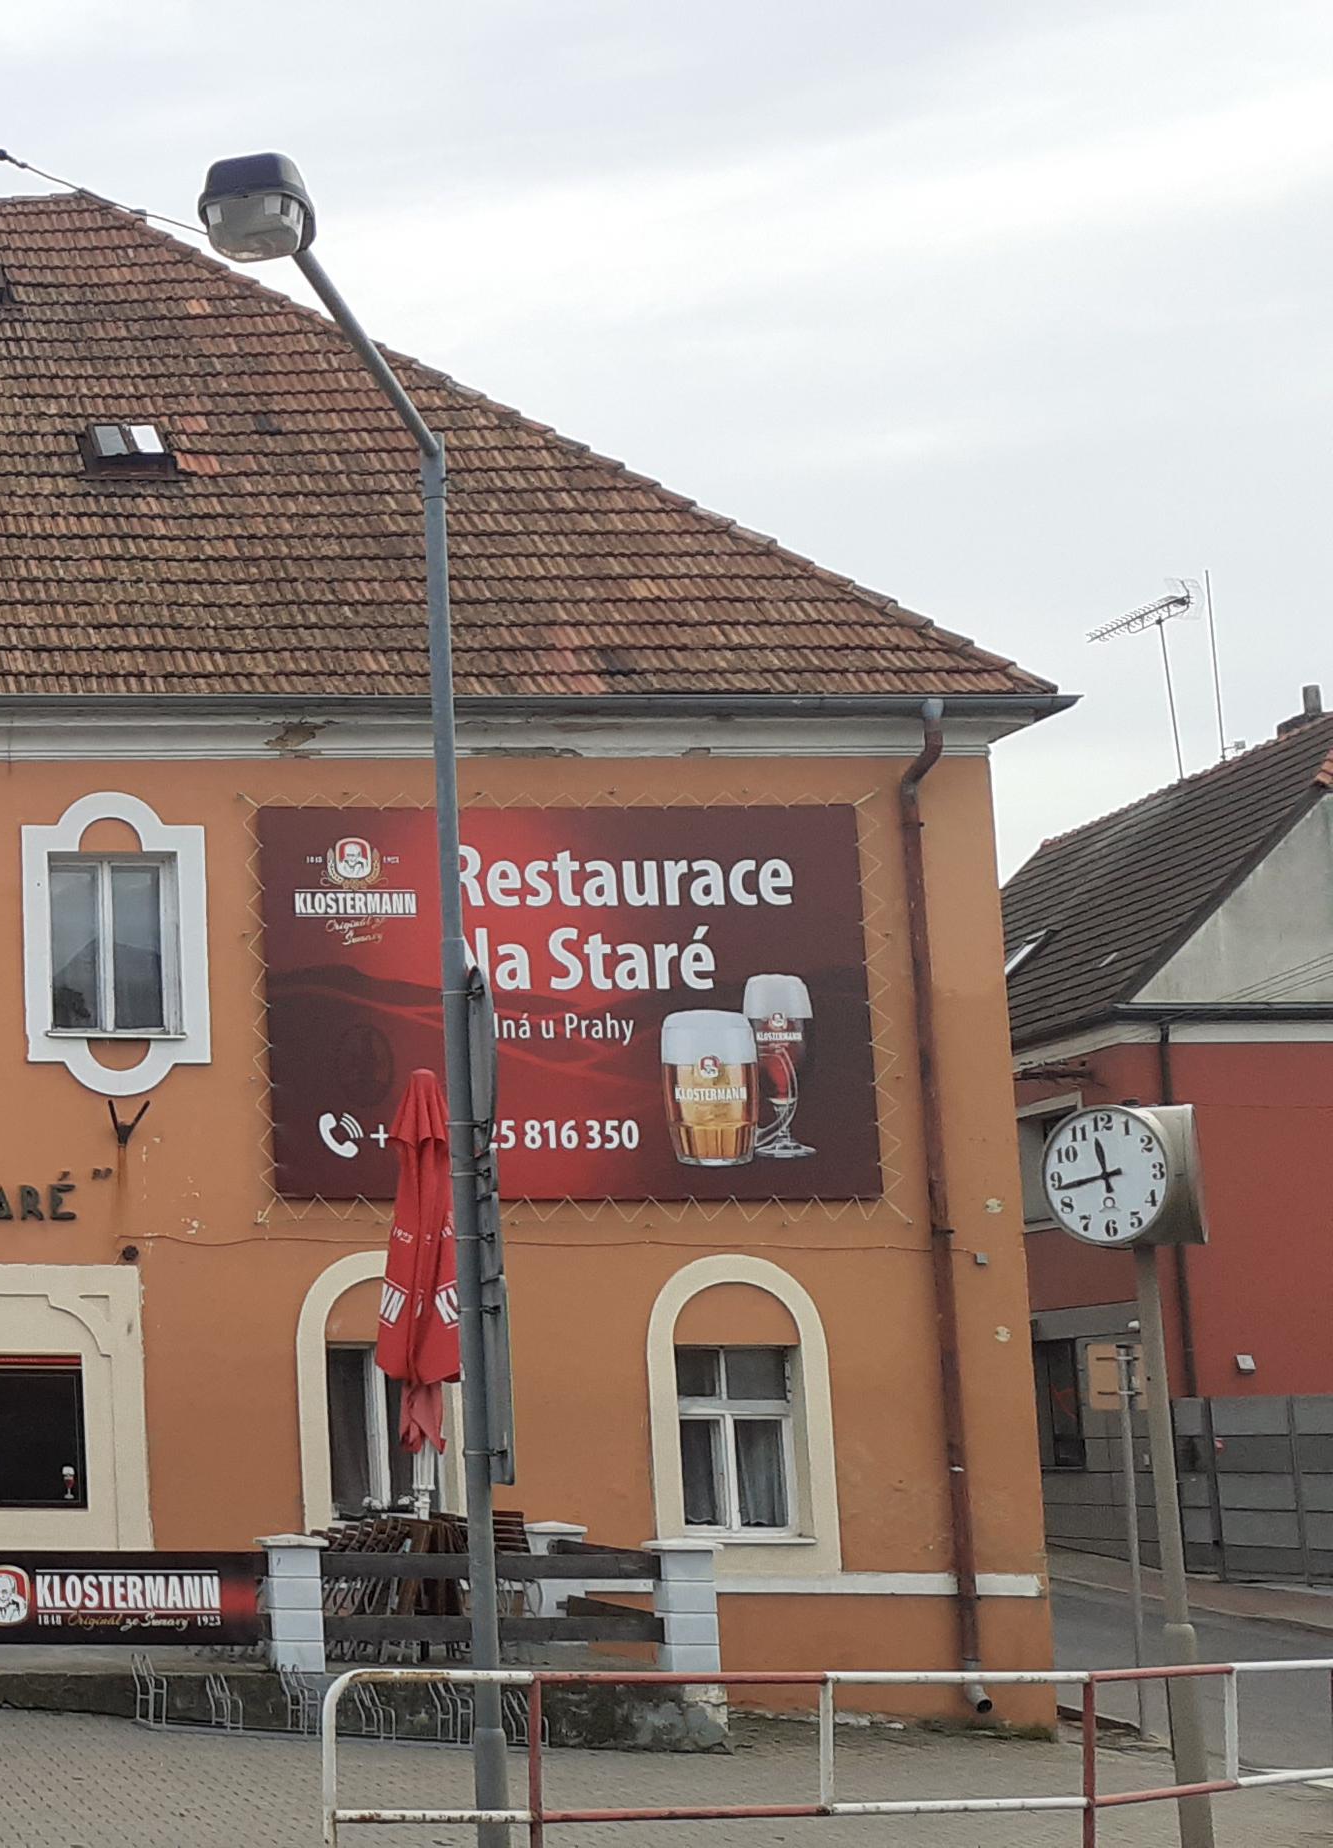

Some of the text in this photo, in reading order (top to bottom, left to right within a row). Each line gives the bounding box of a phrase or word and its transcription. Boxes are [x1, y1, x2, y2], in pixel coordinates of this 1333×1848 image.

[458, 843, 795, 907] Restaurace
[294, 892, 417, 914] KLOSTERMANN
[548, 925, 716, 990] Staré
[540, 1019, 555, 1039] u
[565, 1011, 635, 1047] Prahy
[674, 1086, 748, 1101] KLOSTERMANN
[1092, 1113, 1114, 1132] 12
[1122, 1118, 1132, 1136] 1
[524, 1119, 579, 1149] 816
[585, 1119, 640, 1150] 350
[1070, 1124, 1088, 1142] 11
[1139, 1135, 1154, 1153] 2
[1056, 1145, 1079, 1164] 10
[1151, 1161, 1166, 1180] 3
[1050, 1171, 1063, 1191] 9
[1060, 1195, 1075, 1214] 8
[1144, 1189, 1159, 1207] 4
[1079, 1213, 1092, 1232] 7
[1104, 1219, 1119, 1237] 6
[1129, 1211, 1144, 1228] 5
[35, 1574, 222, 1609] KLOSTERMANN
